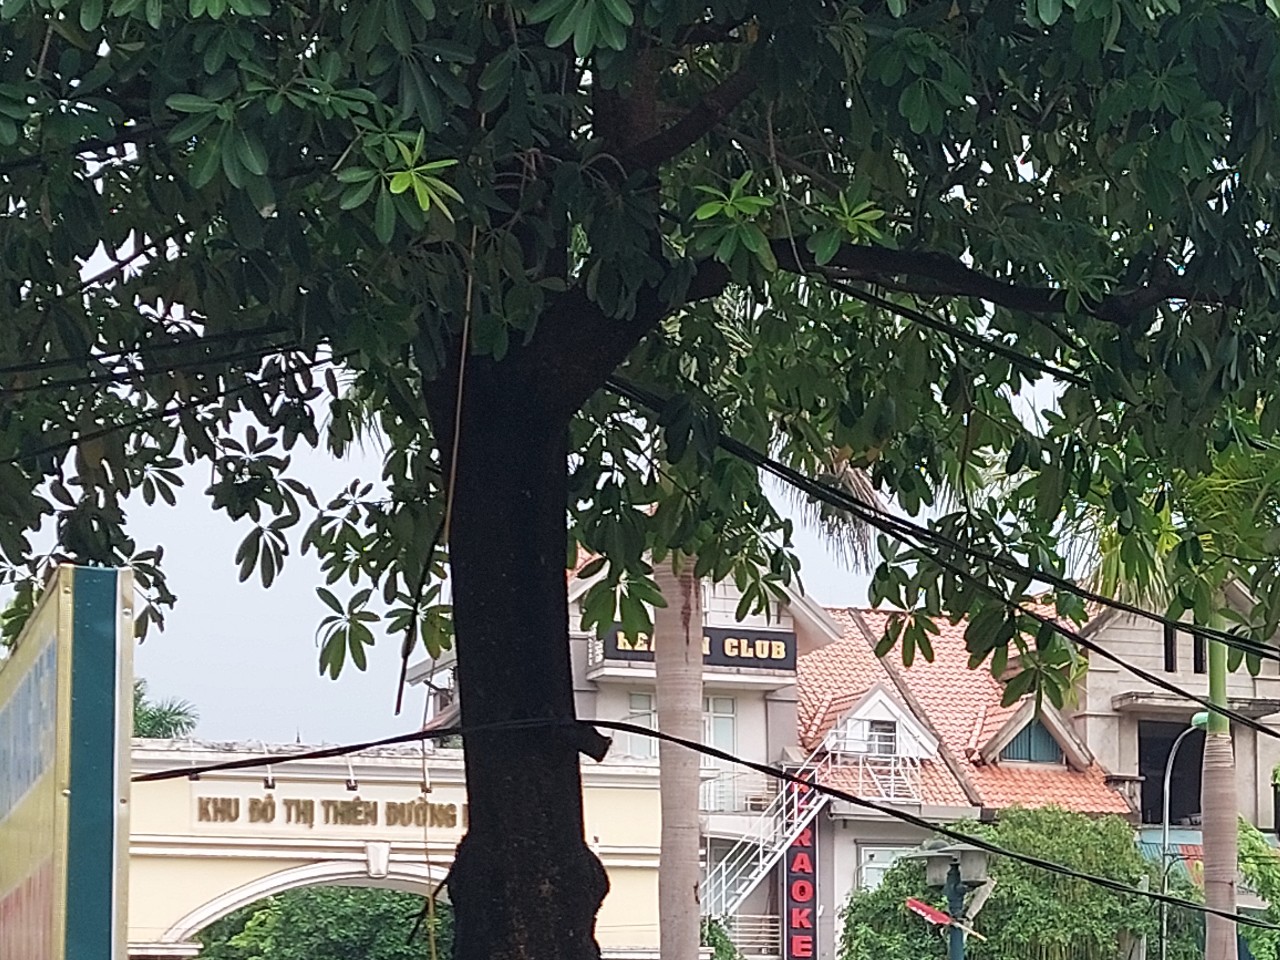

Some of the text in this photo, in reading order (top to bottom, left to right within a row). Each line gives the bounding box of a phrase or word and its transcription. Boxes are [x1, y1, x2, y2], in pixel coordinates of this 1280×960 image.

[724, 638, 786, 659] CLUB
[198, 797, 239, 822] KHU
[249, 794, 276, 823] ĐÔ
[283, 799, 314, 829] THỊ
[320, 796, 377, 825] THIÊN
[790, 773, 813, 958] KRAOKE
